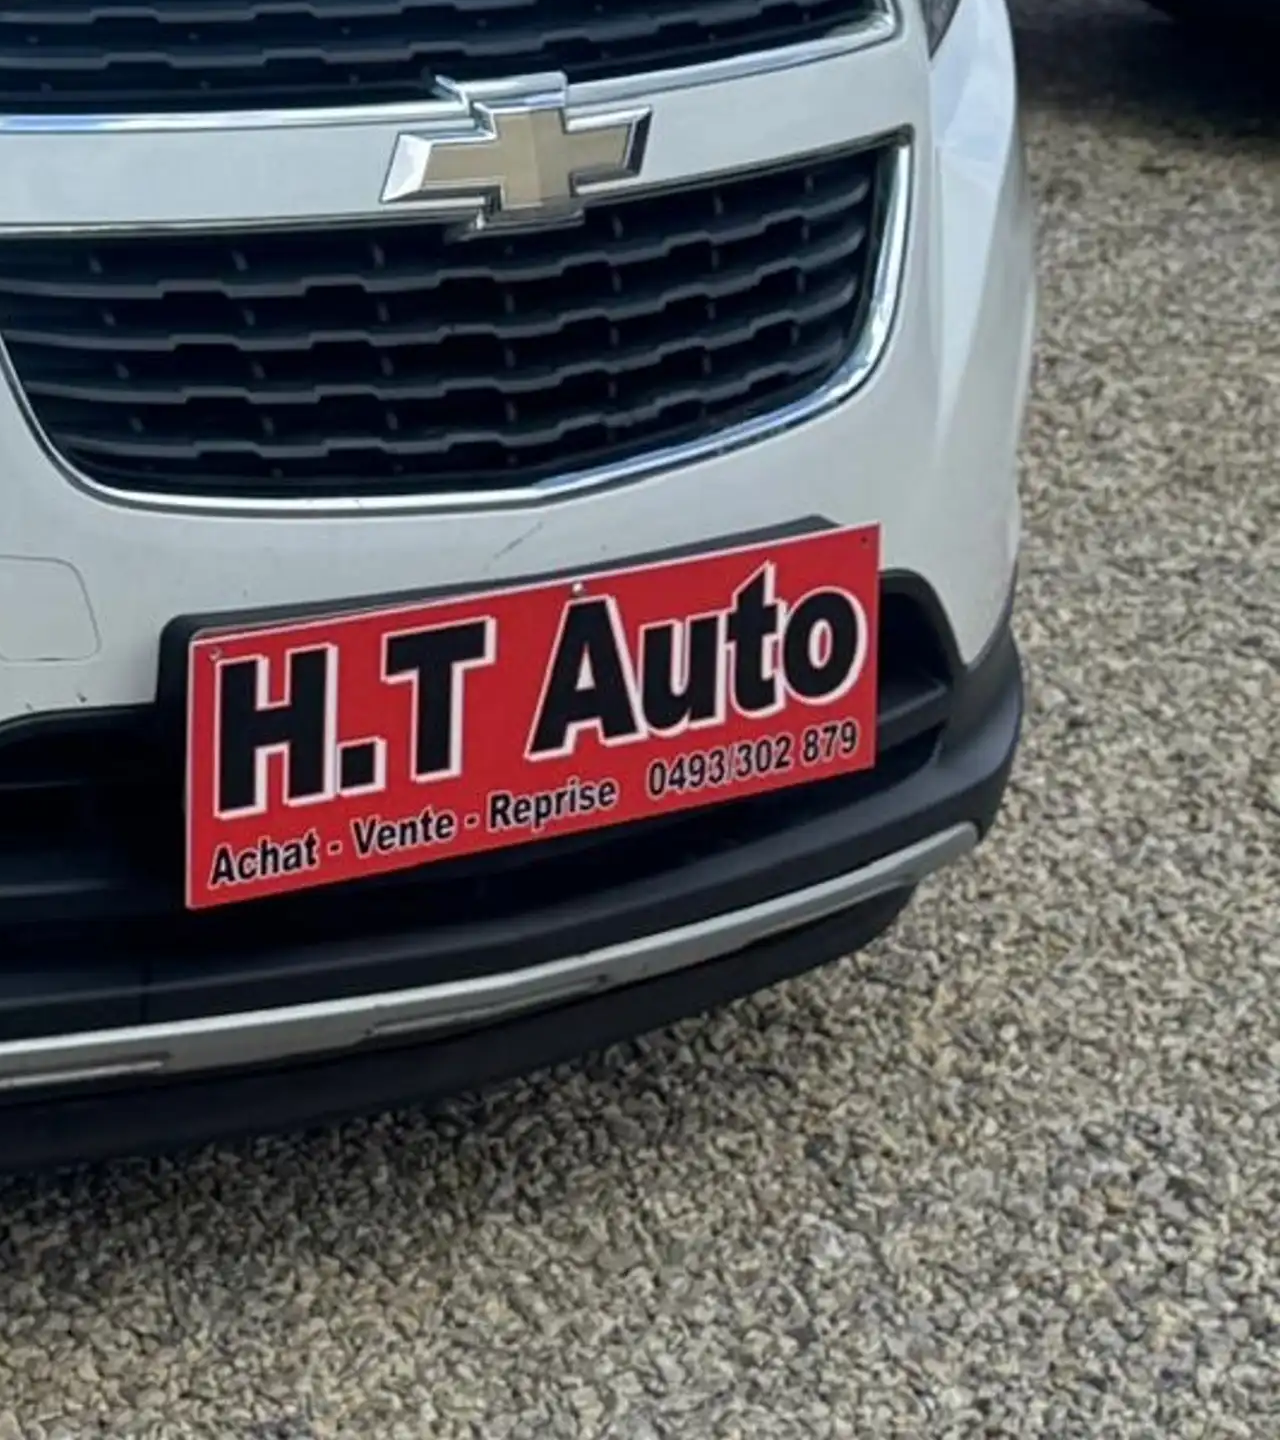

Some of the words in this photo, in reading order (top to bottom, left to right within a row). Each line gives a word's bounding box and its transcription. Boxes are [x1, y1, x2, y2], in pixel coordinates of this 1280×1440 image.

[212, 615, 497, 821] H.T
[526, 559, 867, 762] Auto
[208, 827, 320, 890] Achat
[351, 804, 456, 858] Vente
[485, 777, 619, 834] Reprise
[647, 734, 793, 798] 0493/302
[800, 718, 860, 764] 879
